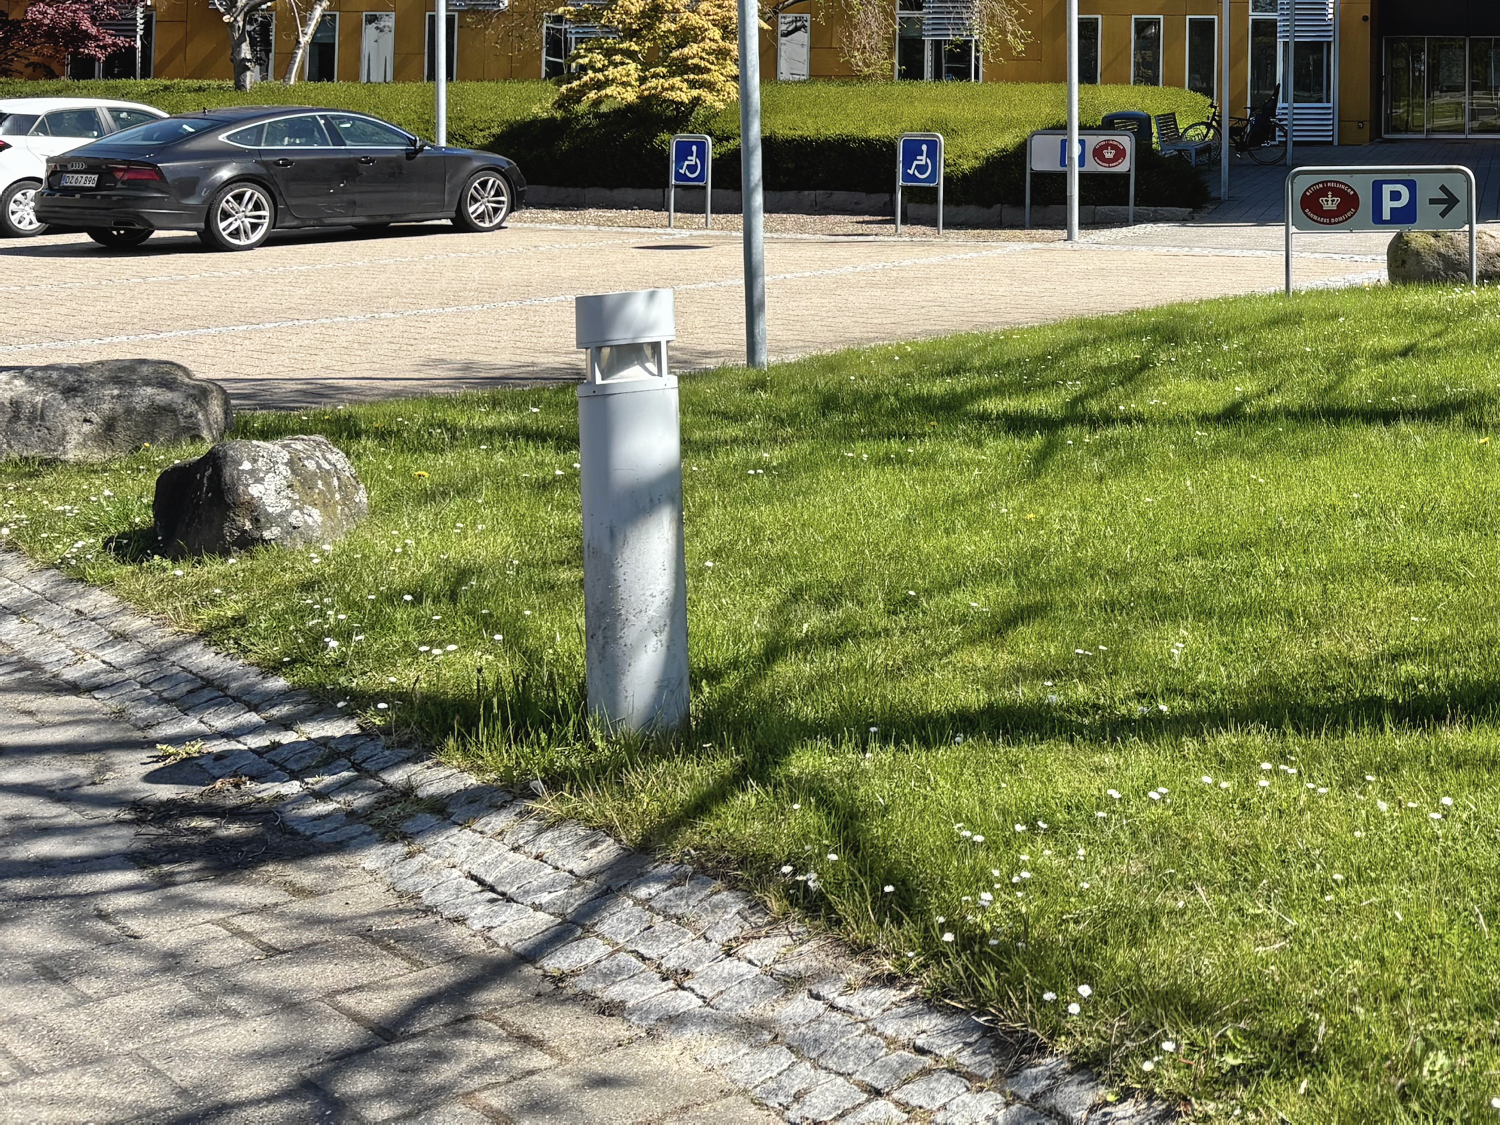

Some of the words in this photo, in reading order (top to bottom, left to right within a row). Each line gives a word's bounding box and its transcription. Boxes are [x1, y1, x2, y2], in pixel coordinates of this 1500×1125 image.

[1306, 183, 1323, 196] RETTEN
[1382, 184, 1410, 221] P
[1305, 208, 1329, 223] DANMARKS
[1331, 208, 1355, 223] DOMSTOLE
